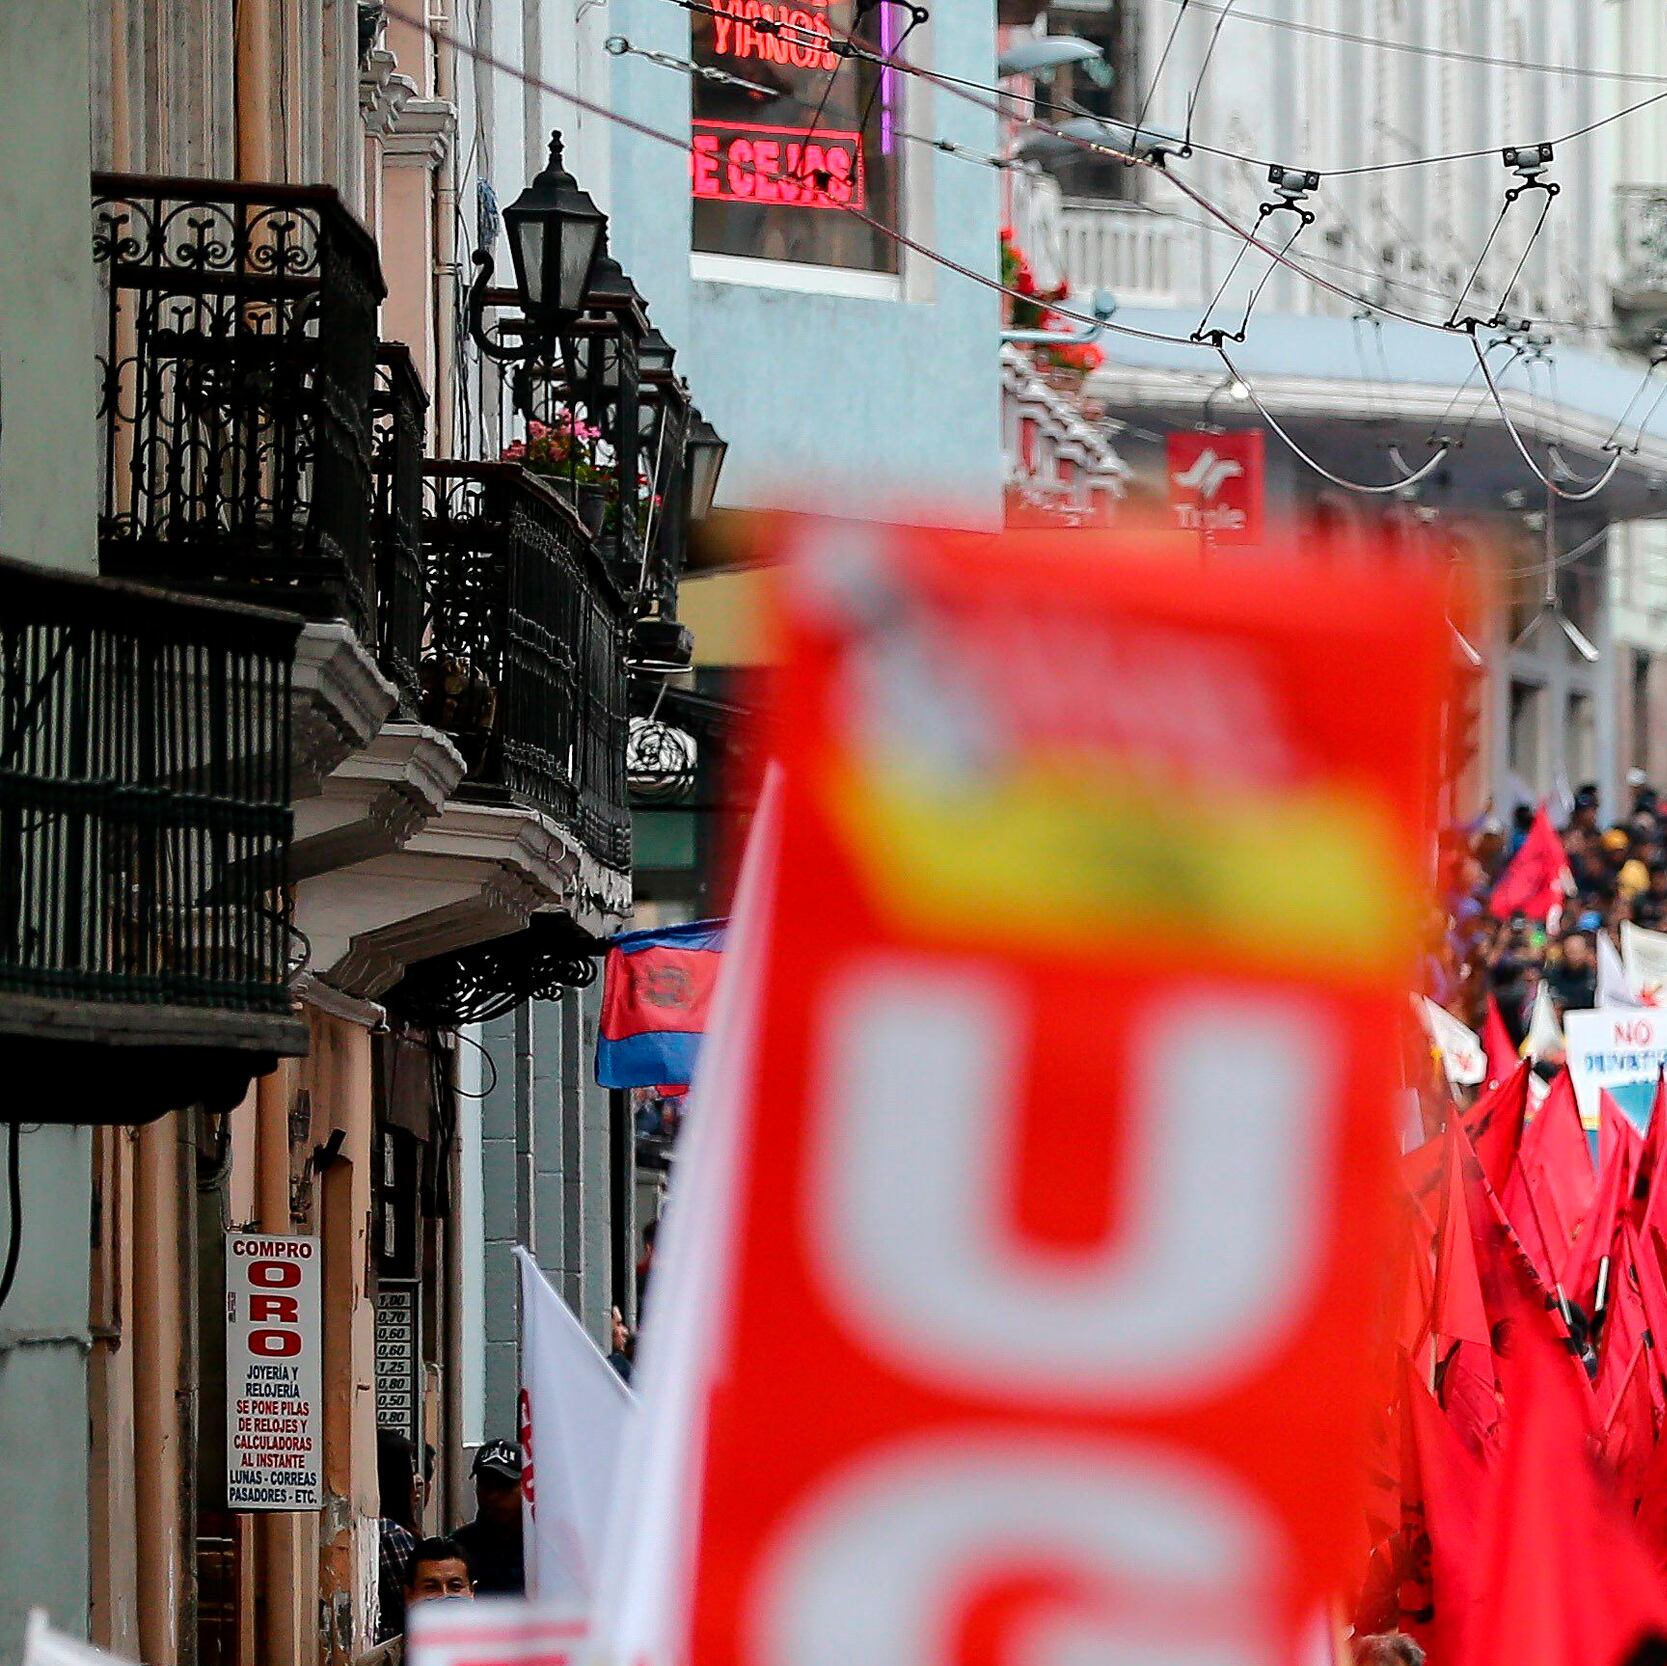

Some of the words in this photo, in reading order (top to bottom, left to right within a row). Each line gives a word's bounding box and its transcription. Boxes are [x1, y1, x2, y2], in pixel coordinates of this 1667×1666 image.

[1613, 1020, 1655, 1046] NO
[232, 1240, 312, 1259] COMPRO
[247, 1260, 303, 1358] ORO
[378, 1310, 405, 1324] 0,70
[378, 1327, 405, 1341] 0,60
[378, 1344, 405, 1358] 0,60
[247, 1363, 289, 1381] JOYERÍA
[291, 1366, 299, 1381] Y
[378, 1361, 405, 1375] 1,25
[245, 1381, 300, 1398] RELOJERÍA
[378, 1378, 405, 1392] 0,80
[236, 1400, 250, 1414] SE
[251, 1401, 279, 1415] PONE
[281, 1402, 310, 1416] PILAS
[378, 1394, 405, 1408] 0,50
[238, 1418, 252, 1432] DE
[254, 1419, 298, 1433] RELOJES
[300, 1420, 308, 1433] Y
[378, 1411, 405, 1425] 0,80
[233, 1435, 313, 1451] CALCULADORAS
[241, 1453, 254, 1467] AL
[256, 1454, 306, 1469] INSTANTE
[229, 1470, 262, 1485] LUNAS
[270, 1471, 317, 1486] CORREAS
[229, 1487, 288, 1503] PASADORES
[295, 1489, 318, 1503] ETC.
